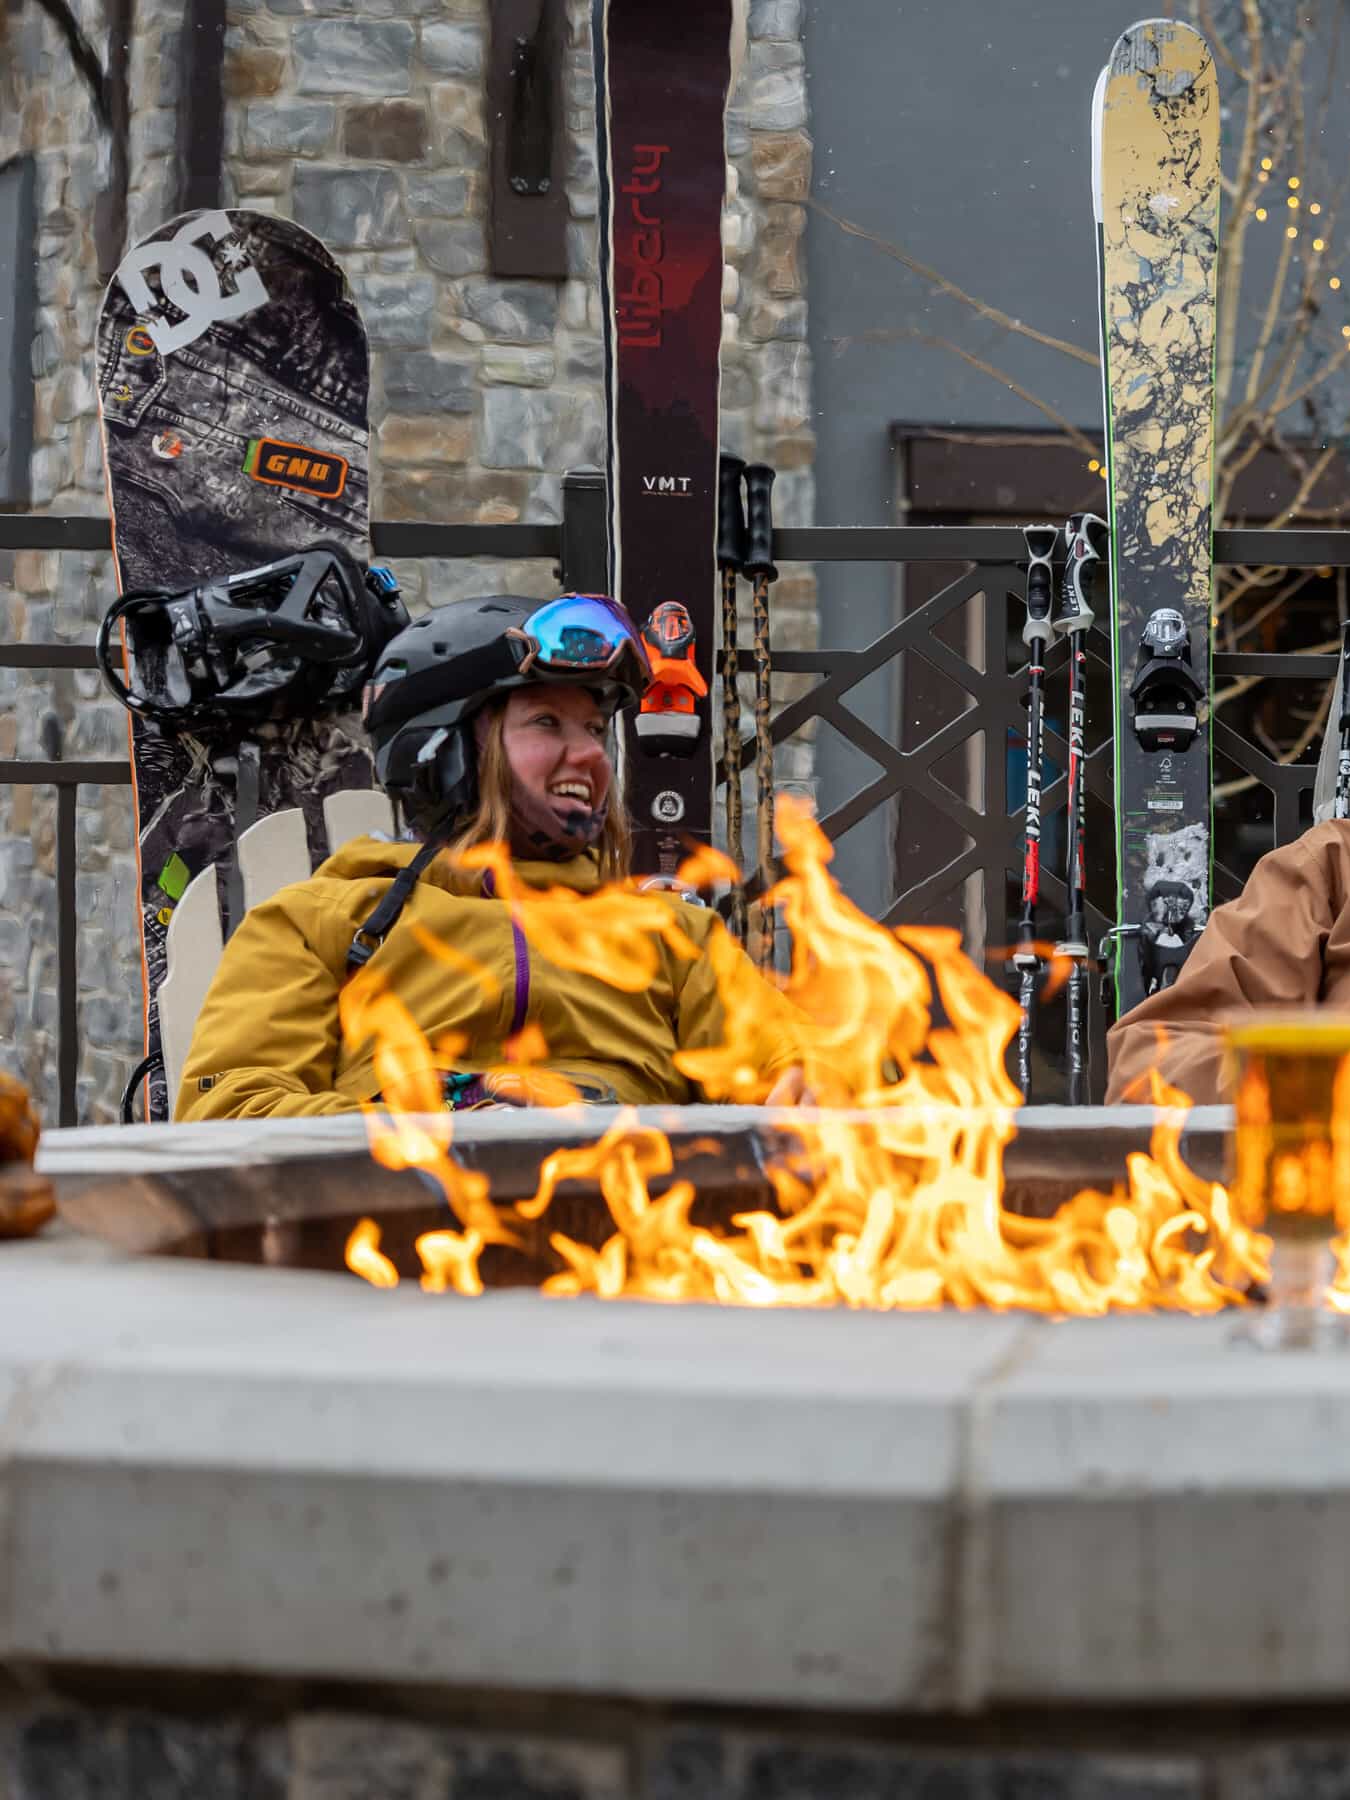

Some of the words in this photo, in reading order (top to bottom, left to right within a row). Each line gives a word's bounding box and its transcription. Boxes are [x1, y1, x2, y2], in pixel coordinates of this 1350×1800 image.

[266, 454, 332, 482] GNU
[642, 476, 691, 491] VMT
[1071, 690, 1085, 757] LEKI
[1026, 769, 1041, 836] LEKI
